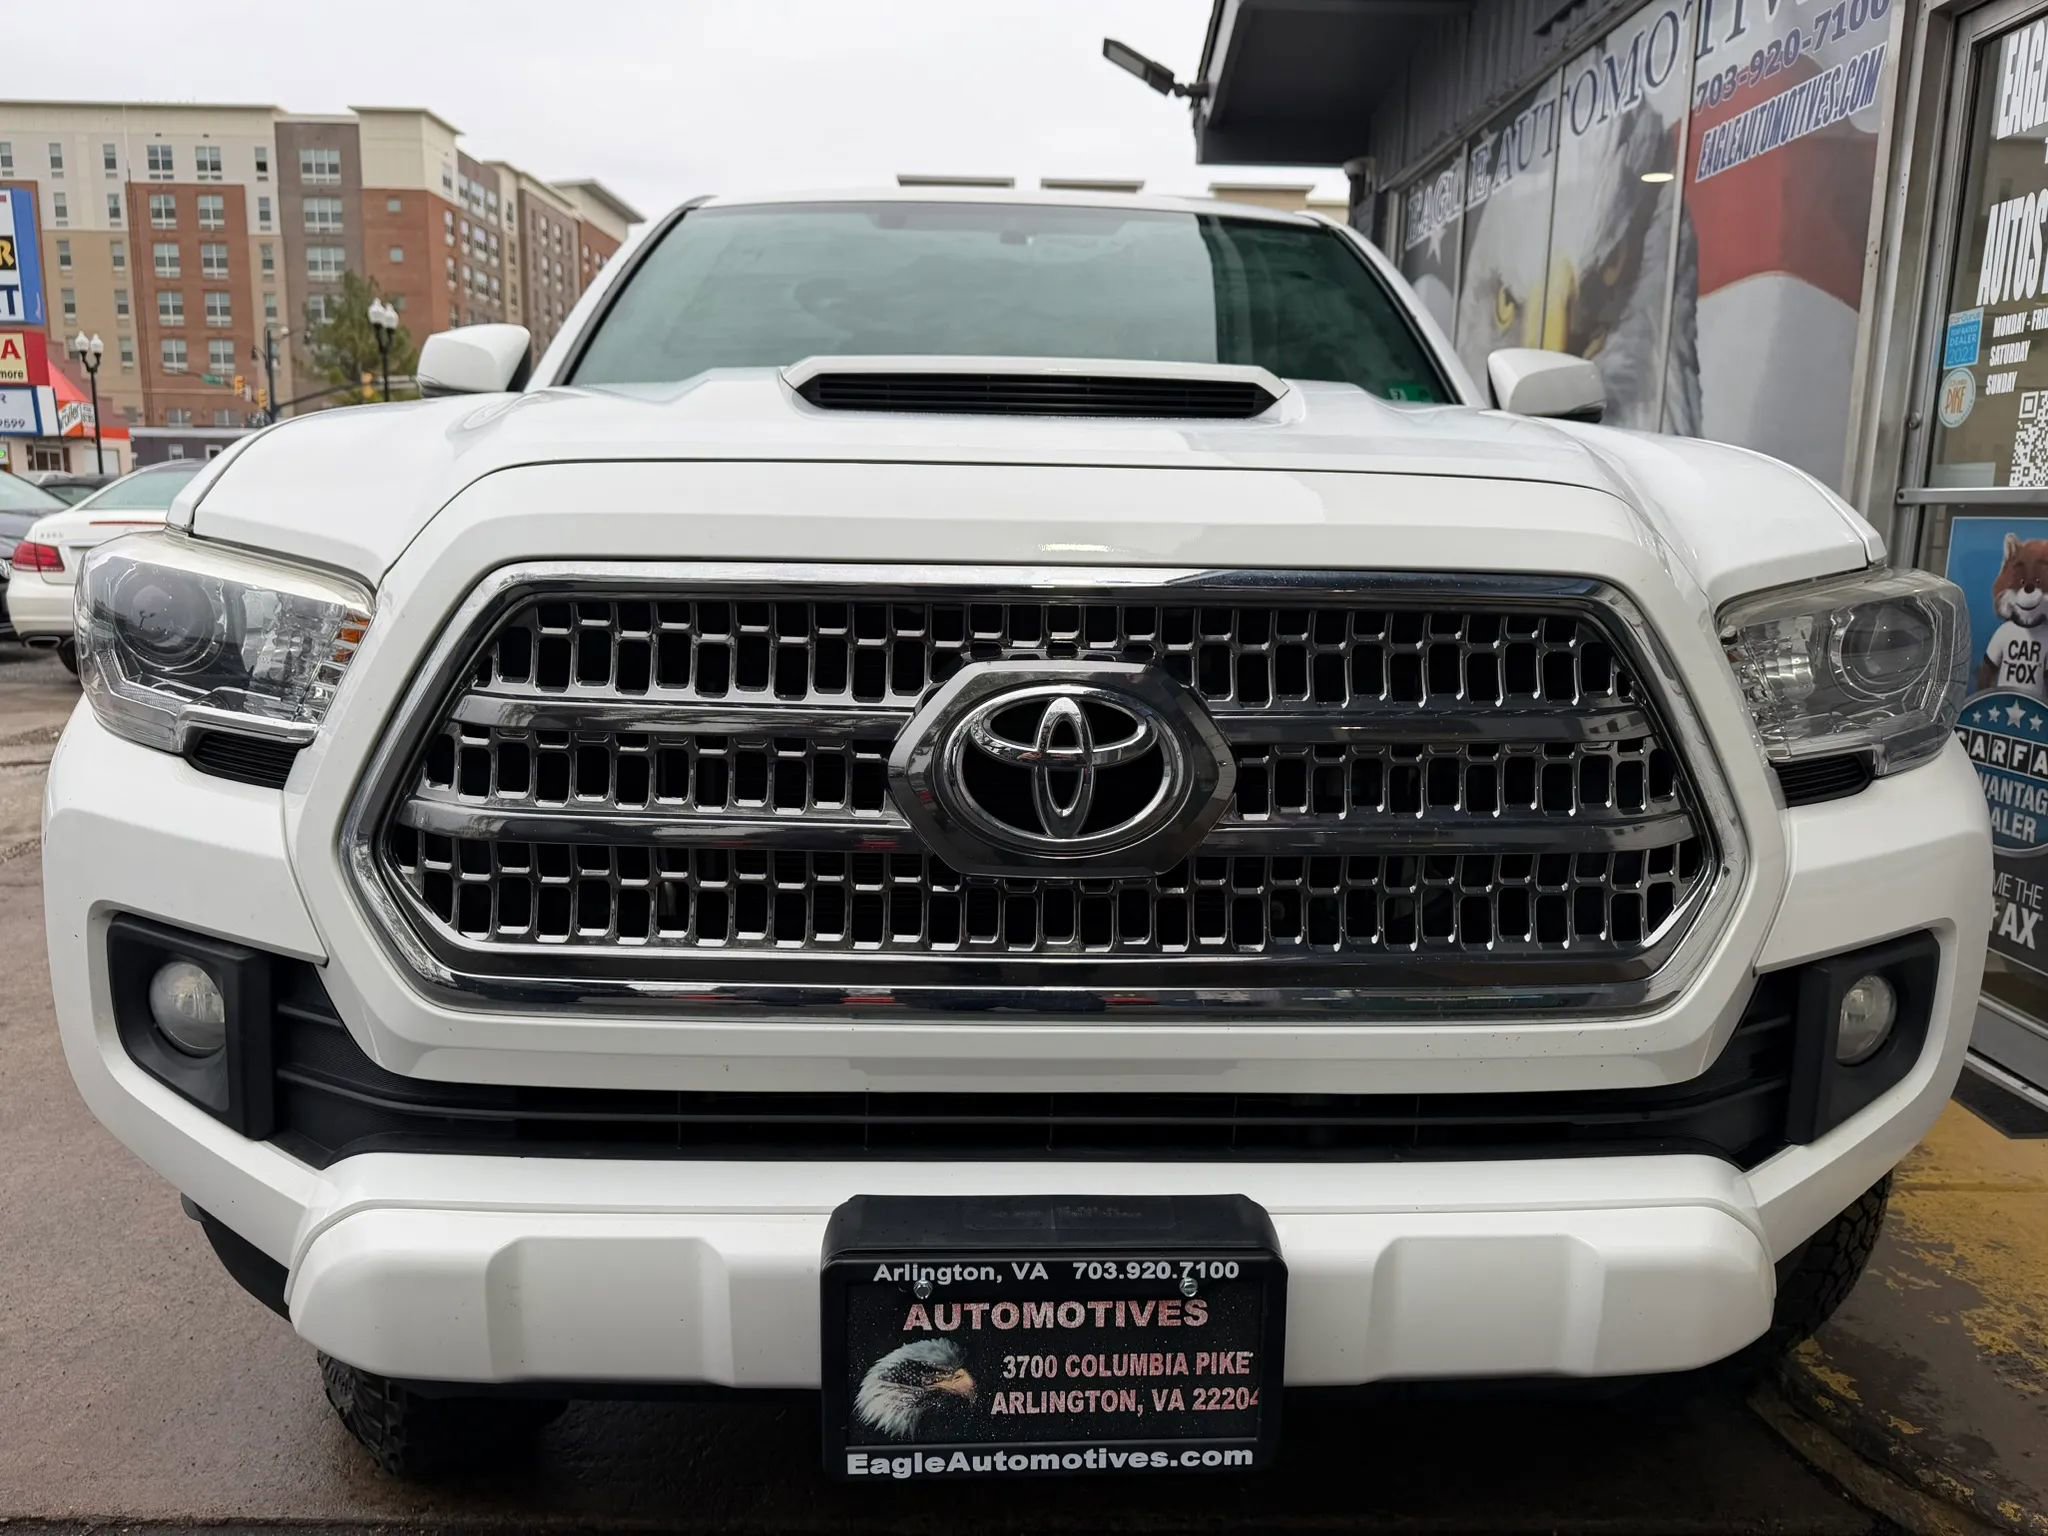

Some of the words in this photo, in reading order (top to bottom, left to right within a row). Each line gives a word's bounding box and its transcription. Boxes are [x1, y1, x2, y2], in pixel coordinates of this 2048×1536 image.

[1696, 0, 1888, 113] 703-920-7100
[1696, 43, 1886, 182] EAGLEAUTOMOTIVES.COM
[1976, 188, 2048, 306] AUTOS
[1949, 333, 1978, 347] DEALER
[1993, 311, 2028, 338] MONDAY
[1989, 340, 2031, 367] SATURDAY
[1985, 371, 2018, 396] SUNDAY
[2008, 640, 2041, 662] CAR
[2006, 662, 2038, 685] FOX
[1979, 771, 2048, 816] VANTAG
[1991, 805, 2038, 844] ALER
[2014, 877, 2044, 910] THE
[873, 1263, 1002, 1286] Arlington,
[1012, 1262, 1050, 1281] VA
[1073, 1261, 1240, 1280] 703.920.7100
[903, 1299, 1209, 1332] AUTOMOTIVES
[1002, 1355, 1058, 1379] 3700
[1065, 1352, 1189, 1378] COLUMBIA
[1196, 1351, 1250, 1376] PIKE
[991, 1388, 1144, 1418] ARLINGTON,
[1151, 1387, 1186, 1412] VA
[847, 1448, 1253, 1479] EagleAutomotives.com
